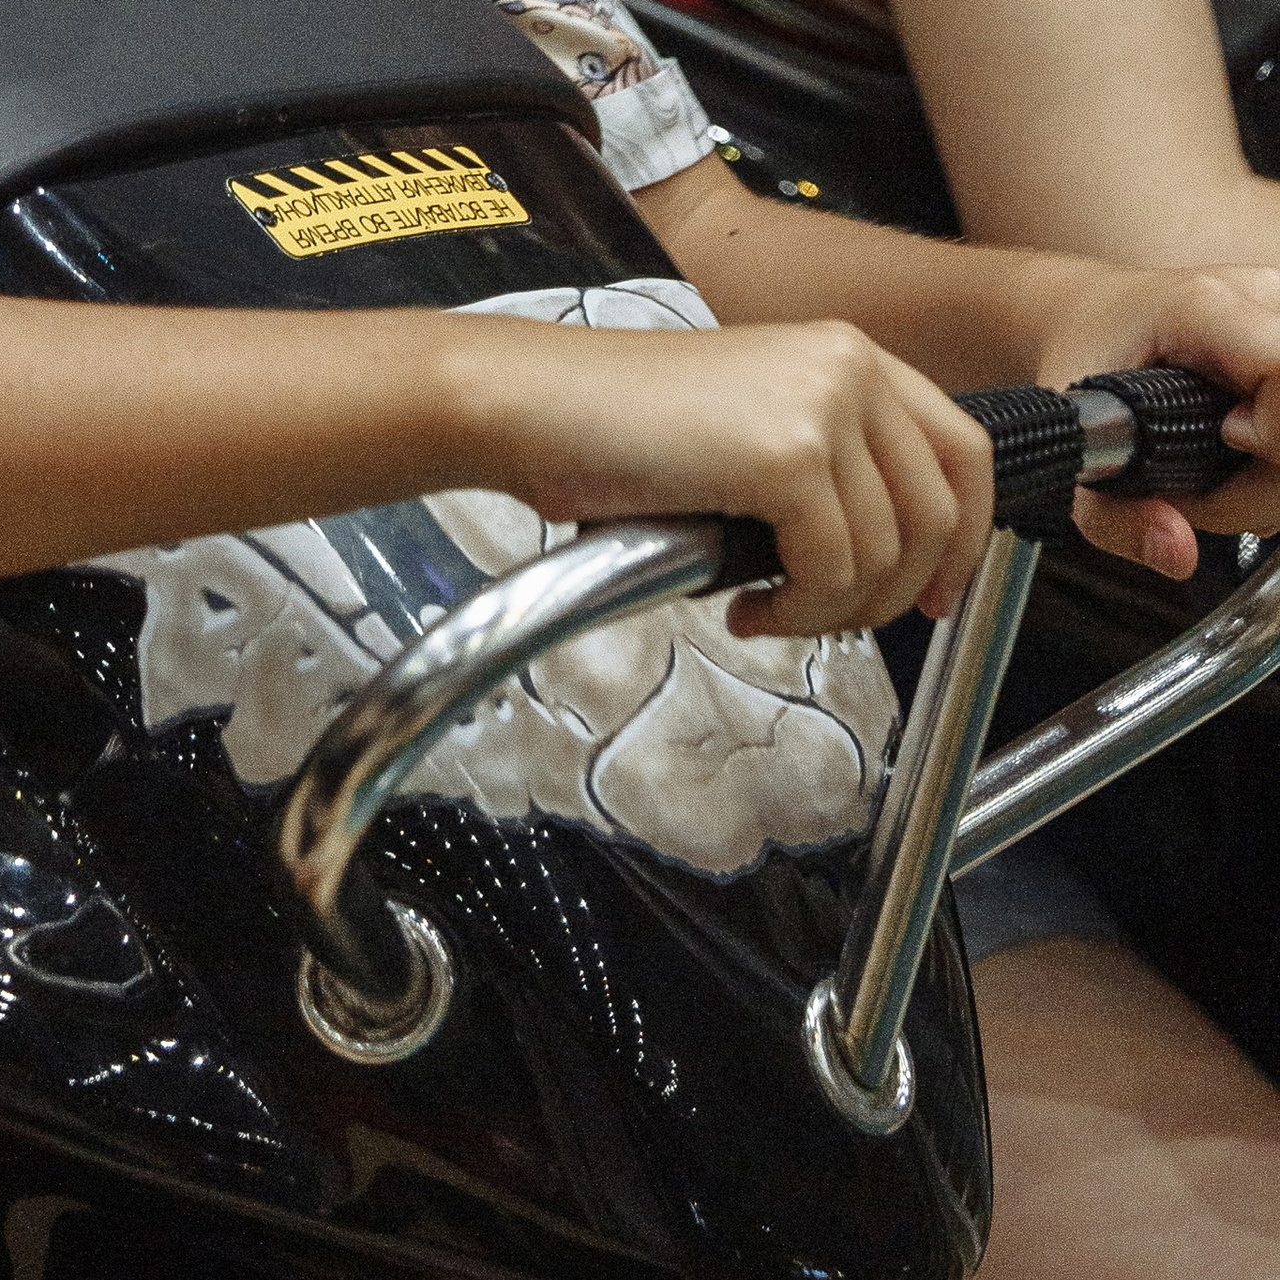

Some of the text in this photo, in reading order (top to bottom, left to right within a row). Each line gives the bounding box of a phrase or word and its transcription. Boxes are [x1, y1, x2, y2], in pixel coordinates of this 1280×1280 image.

[272, 170, 495, 219] ДВИЖЕНИЯ АТТРАКЦИОНА
[290, 198, 516, 249] НЕ ВСТАВАЙТЕ ВО ВРЕМЯ
